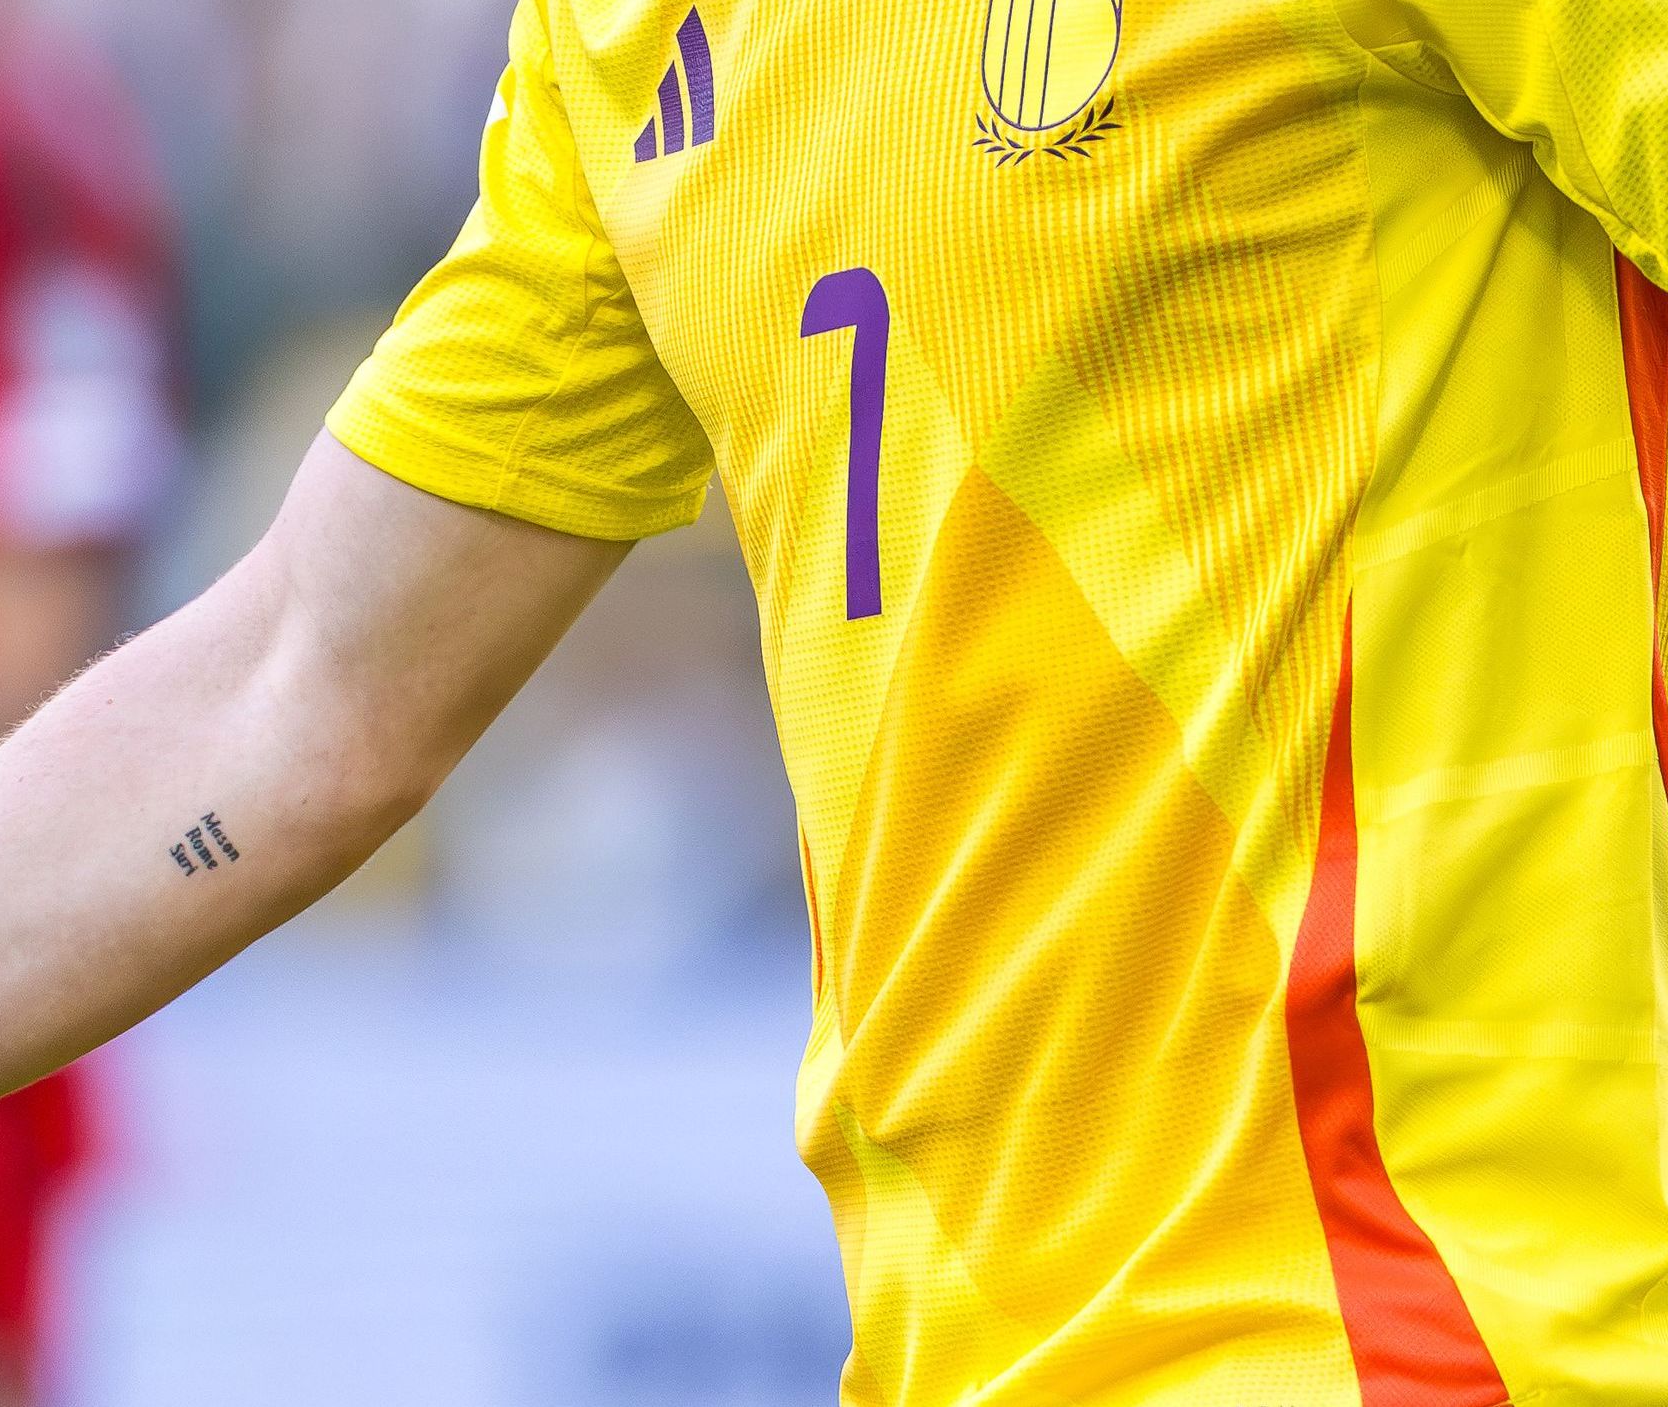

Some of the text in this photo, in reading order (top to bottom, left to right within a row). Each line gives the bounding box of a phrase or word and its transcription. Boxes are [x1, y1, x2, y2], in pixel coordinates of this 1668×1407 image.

[800, 267, 891, 621] 7
[169, 843, 198, 877] Suri
[185, 825, 218, 870] Rome
[200, 812, 240, 862] Mason
